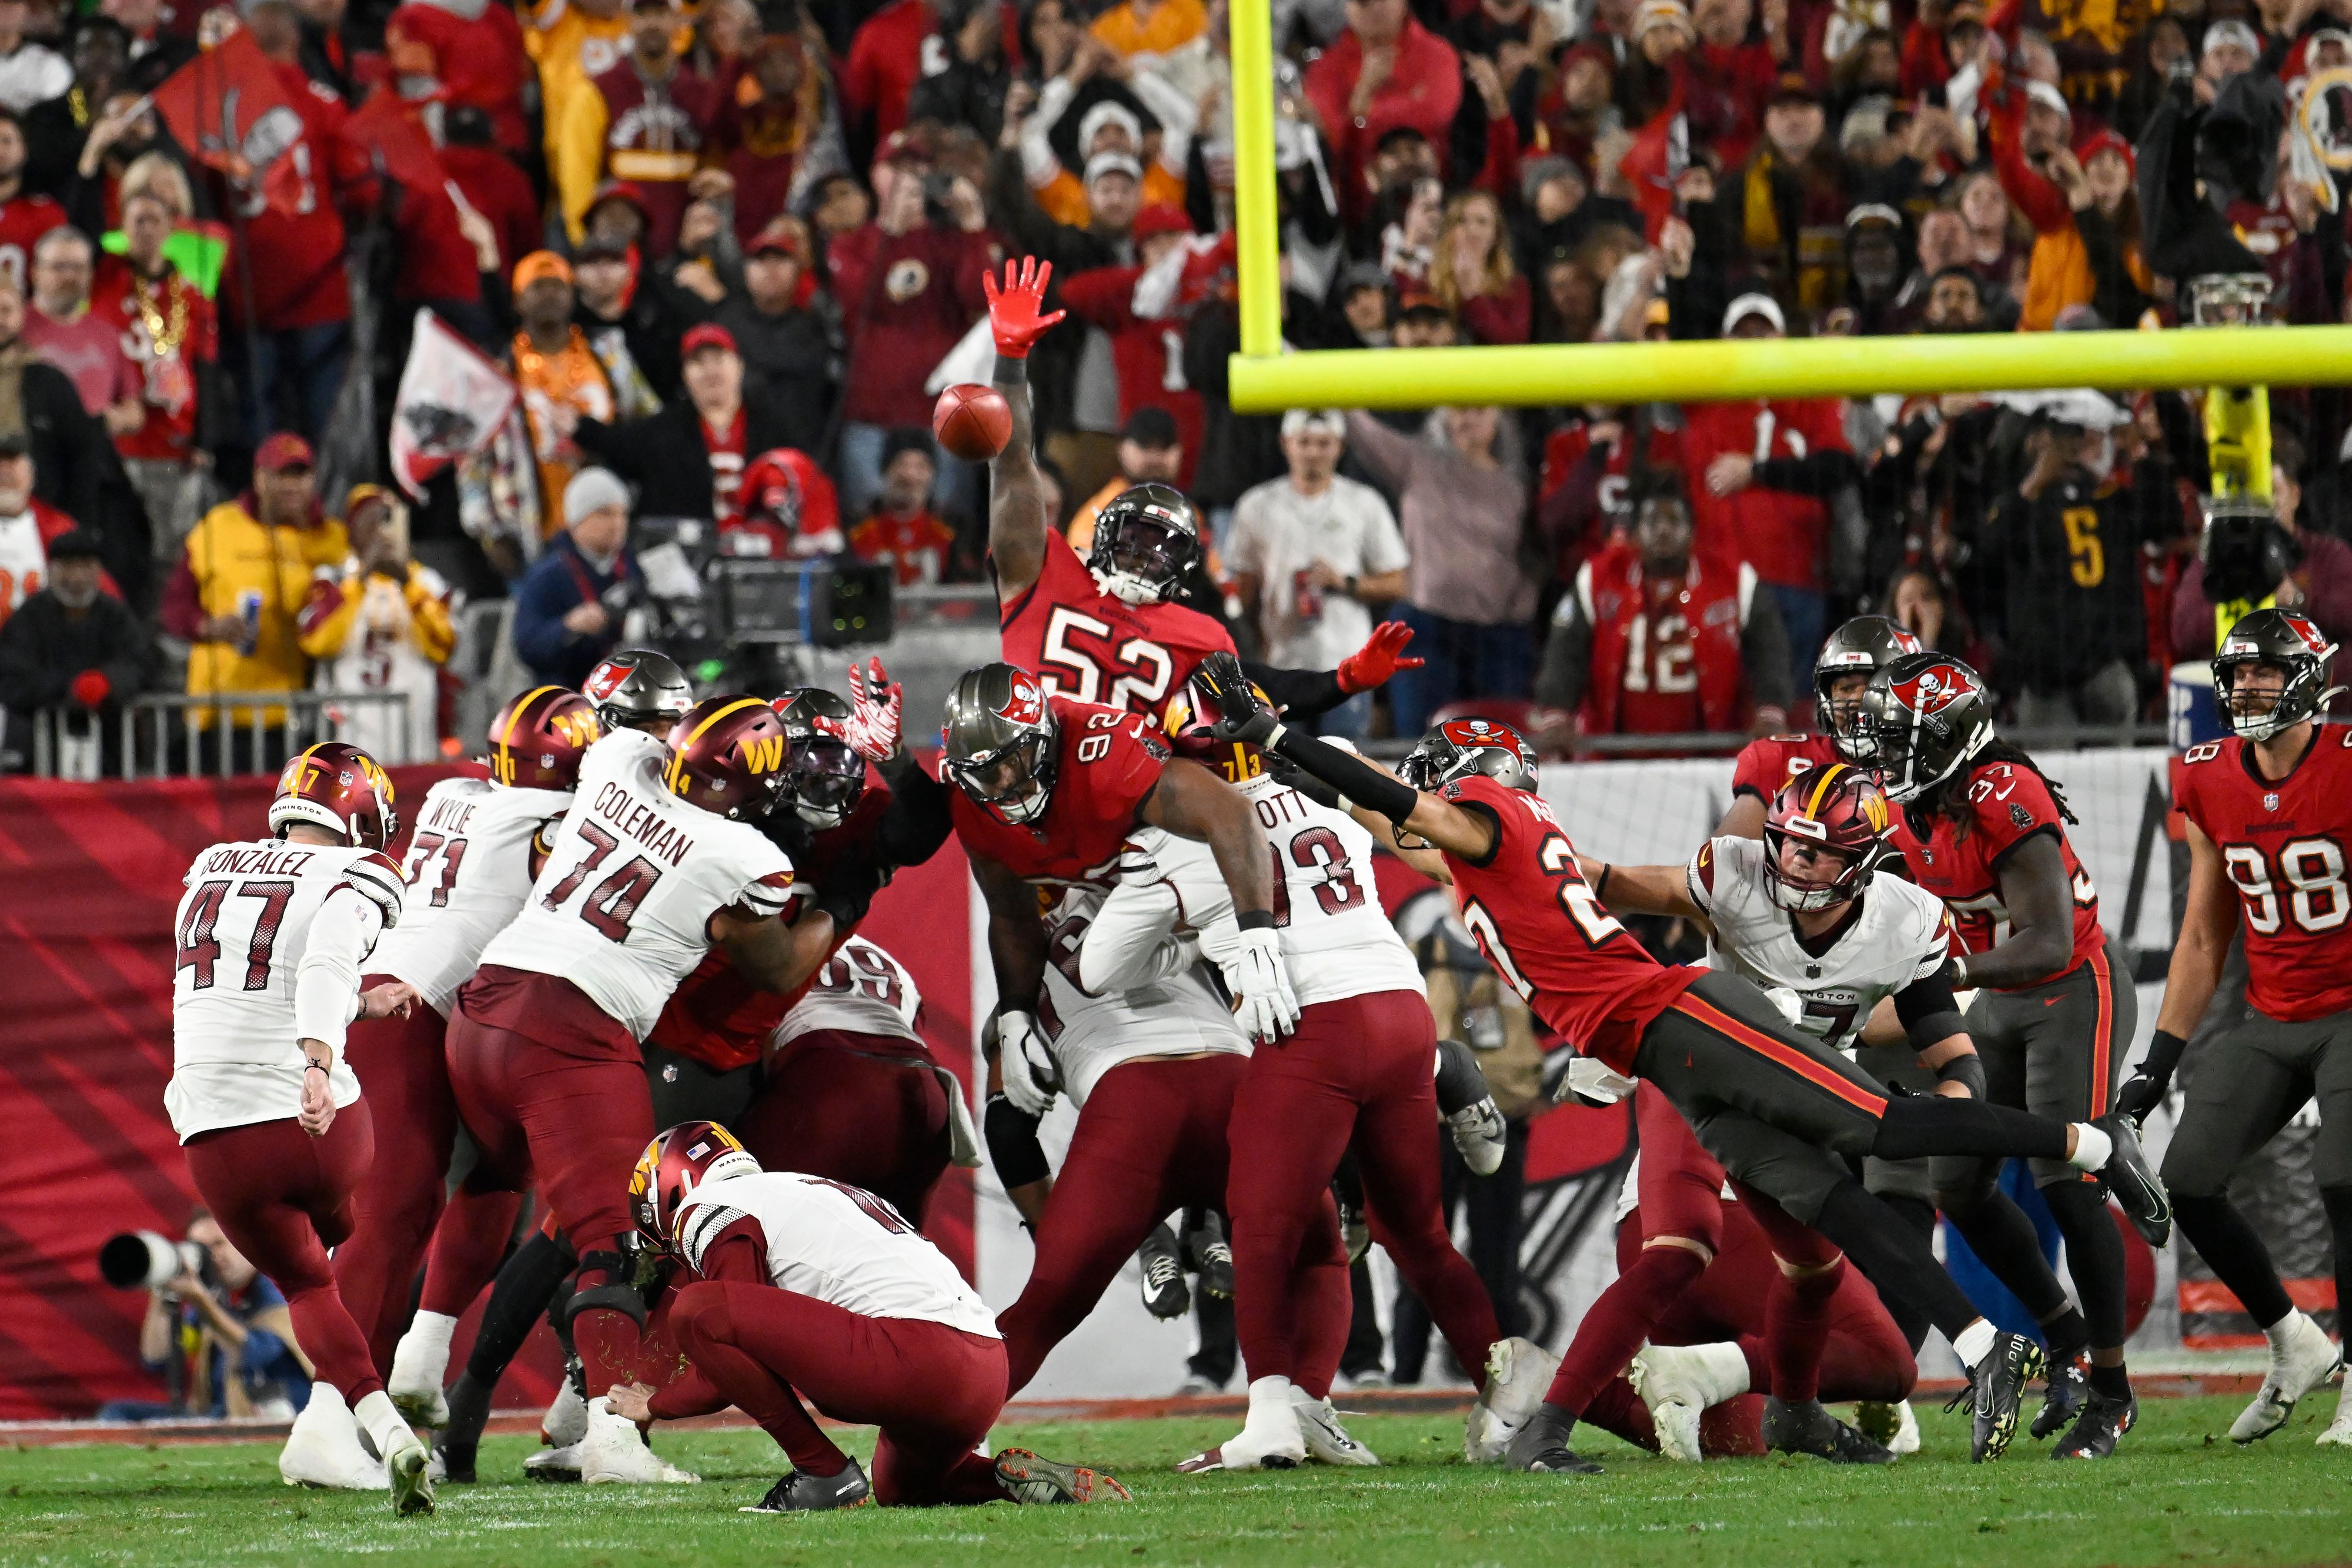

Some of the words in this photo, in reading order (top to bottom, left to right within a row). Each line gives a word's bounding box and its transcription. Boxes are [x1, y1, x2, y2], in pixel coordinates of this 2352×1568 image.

[2062, 507, 2104, 587] 5
[1038, 602, 1174, 729] 52
[1625, 614, 1696, 693] 12
[1222, 754, 1261, 783] 73
[271, 805, 321, 815] WASHINGTON
[594, 782, 694, 868] COLEMAN
[1255, 790, 1308, 829] OTT
[200, 850, 316, 878] GONZALEZ
[405, 831, 467, 907] 71
[541, 818, 663, 945] 74
[2221, 834, 2352, 936] 98
[178, 880, 295, 991] 47
[1805, 1001, 1859, 1048] 7
[2007, 1333, 2027, 1385] VAPOR
